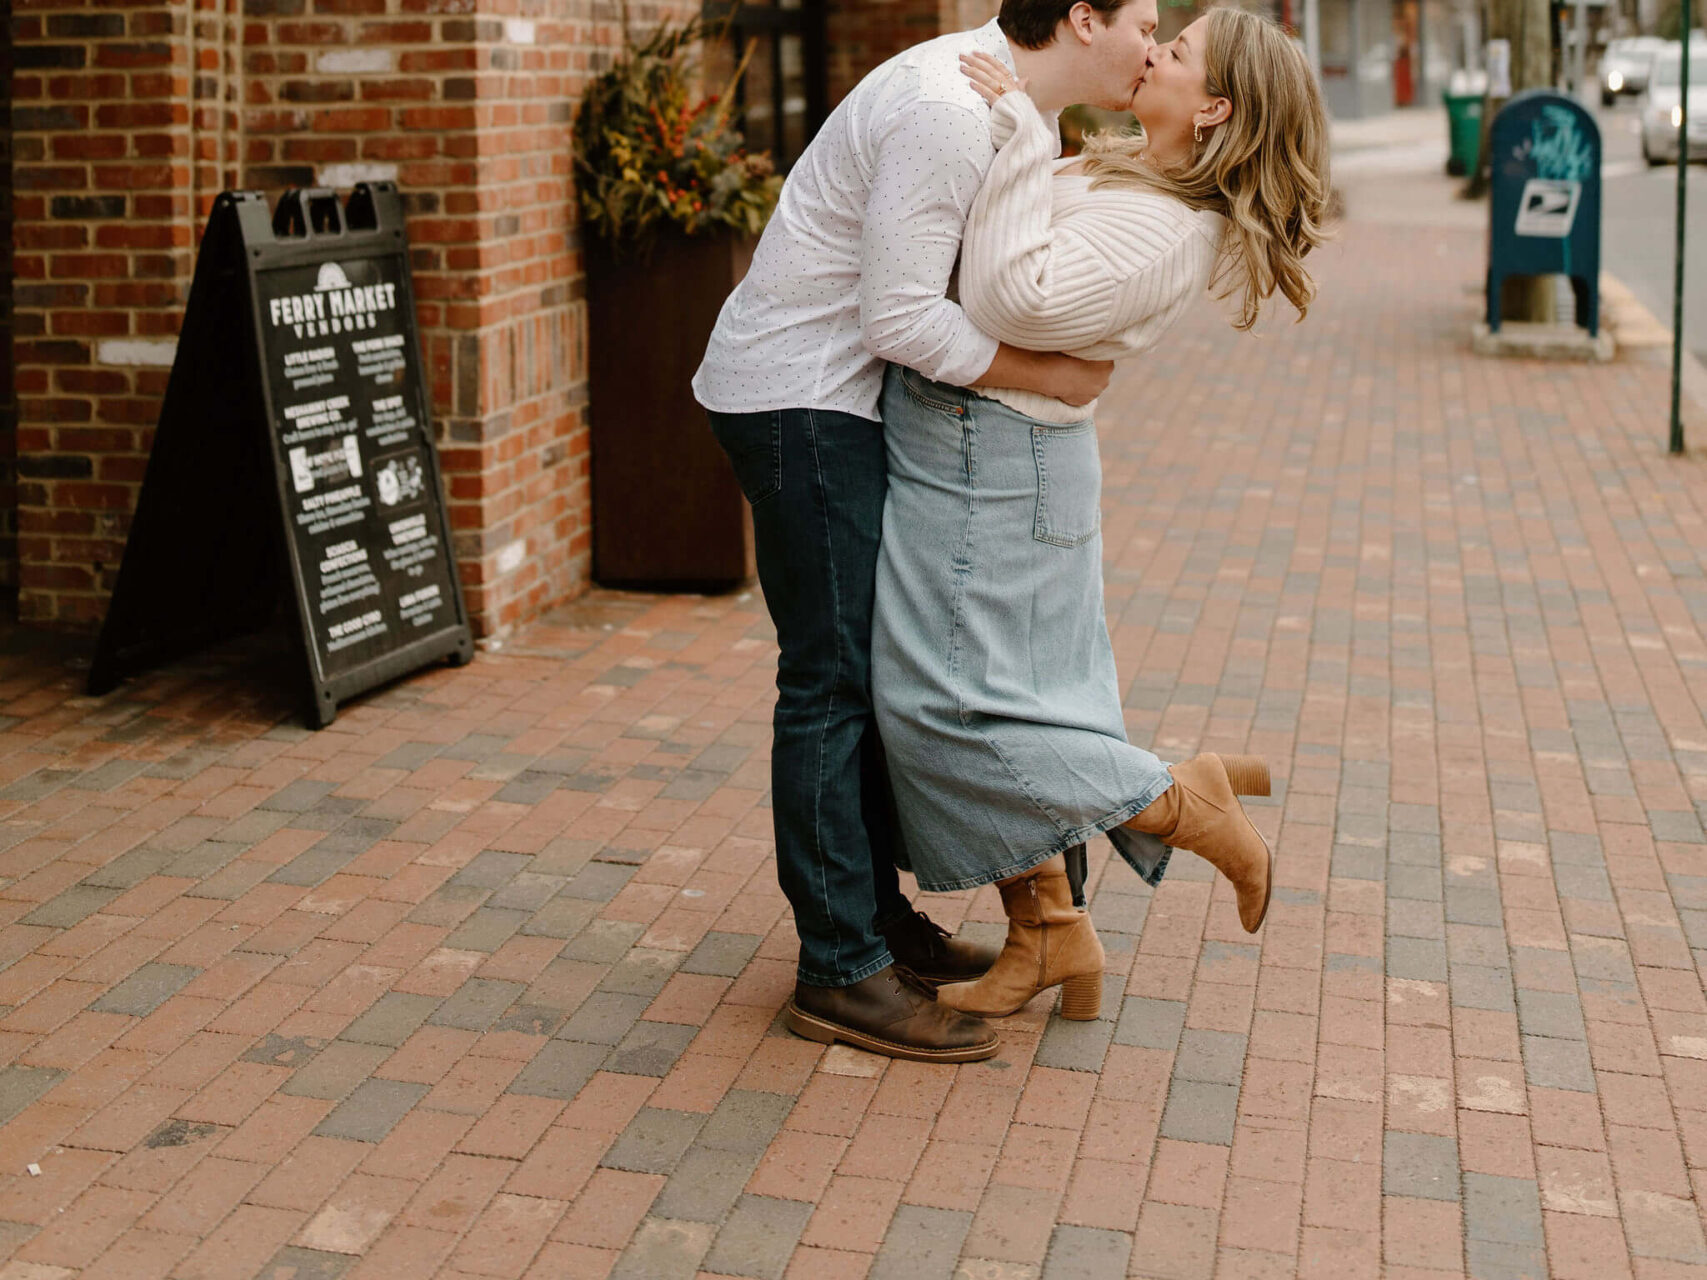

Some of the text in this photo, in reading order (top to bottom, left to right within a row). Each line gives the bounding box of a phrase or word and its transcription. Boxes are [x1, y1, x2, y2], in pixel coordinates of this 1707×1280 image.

[270, 282, 396, 327] FERRY MARKET
[293, 312, 377, 340] VENDORS
